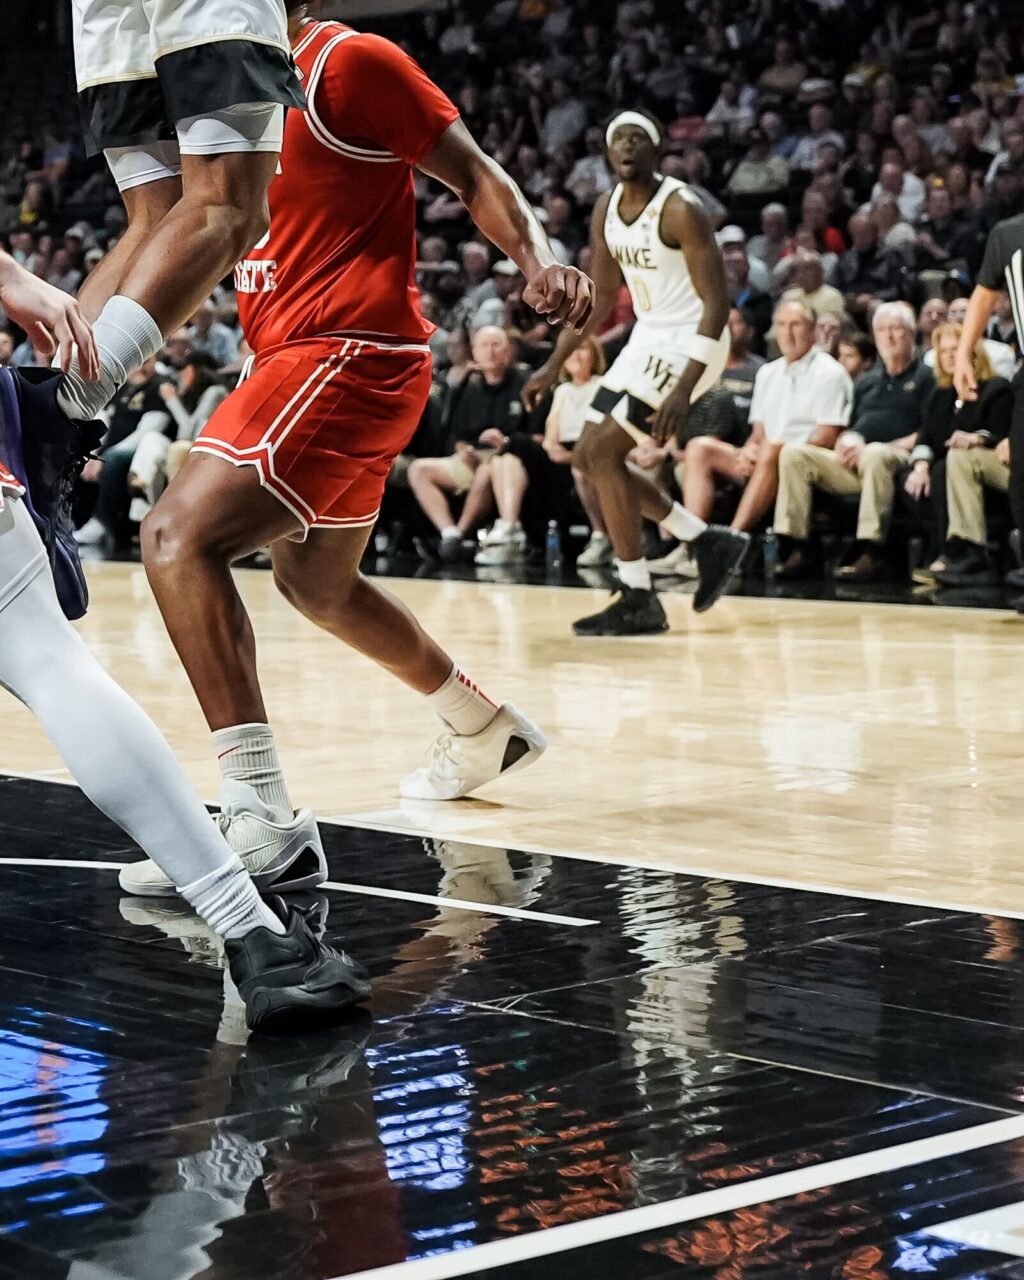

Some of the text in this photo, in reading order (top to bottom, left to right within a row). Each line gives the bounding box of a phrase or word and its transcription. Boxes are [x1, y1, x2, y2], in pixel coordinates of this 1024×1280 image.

[611, 244, 657, 270] WAKE
[234, 260, 278, 293] TATE
[643, 355, 675, 393] WF
